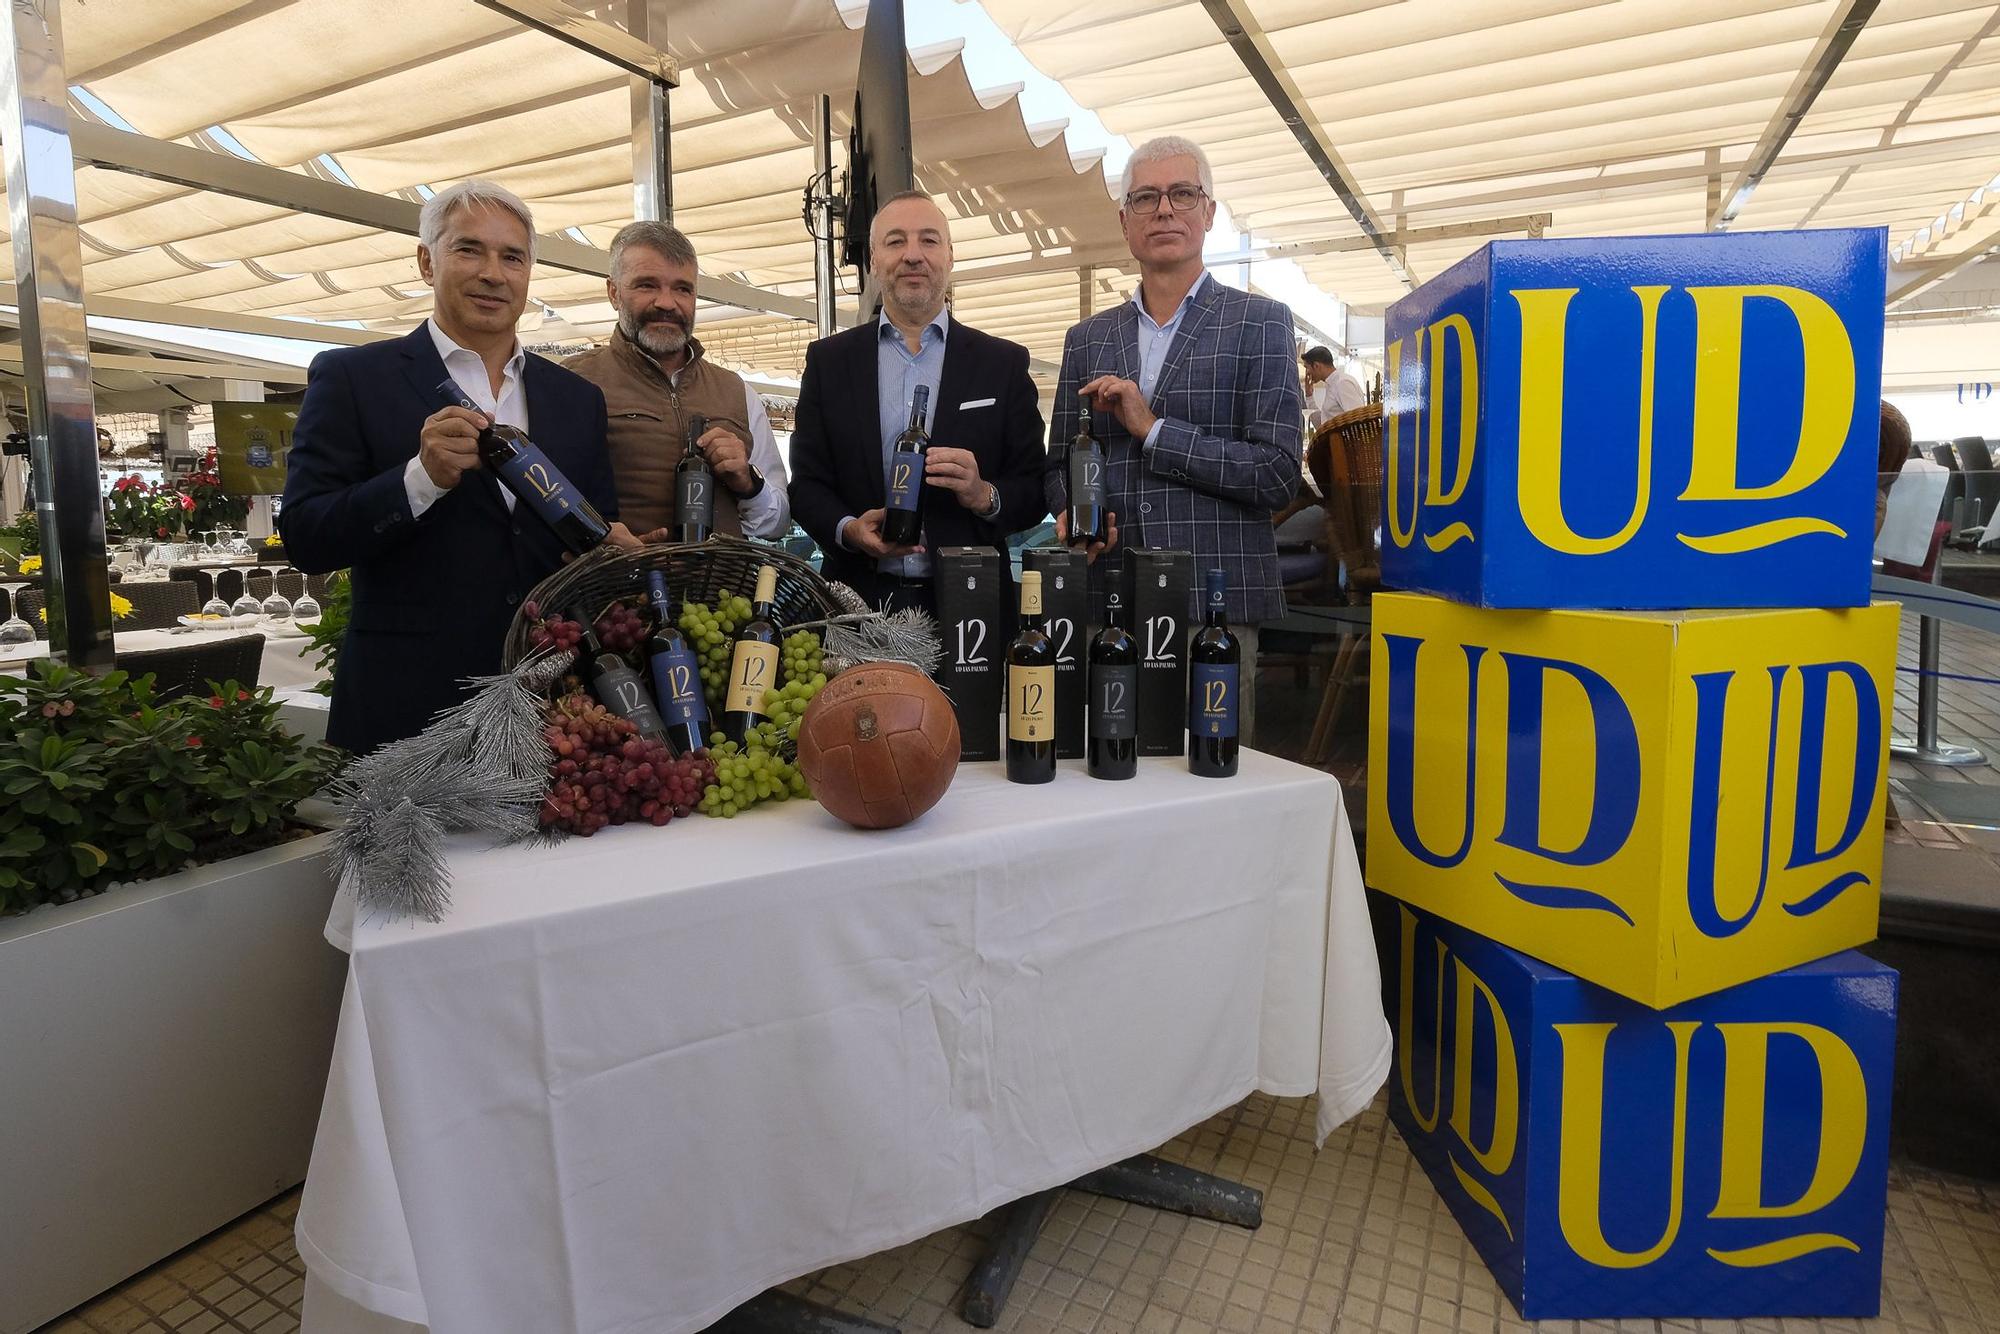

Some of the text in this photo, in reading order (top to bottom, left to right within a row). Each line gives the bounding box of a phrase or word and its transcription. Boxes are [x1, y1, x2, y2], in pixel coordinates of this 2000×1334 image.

[1387, 312, 1480, 551] UD
[1509, 285, 1857, 555] UD
[521, 463, 560, 498] 12
[893, 463, 911, 489] 12
[1083, 462, 1101, 486] 12
[686, 482, 705, 505] 12
[955, 619, 988, 664] 12
[1144, 616, 1177, 660] 12
[667, 665, 695, 699] 12
[740, 656, 765, 687] 12
[615, 681, 648, 713] 12
[1021, 683, 1043, 715] 12
[1103, 681, 1125, 713] 12
[1204, 680, 1228, 712] 12
[1381, 632, 1641, 869] UD
[1686, 660, 1882, 939] UD
[1399, 902, 1519, 1176] UD
[1551, 1021, 1868, 1269] UD
